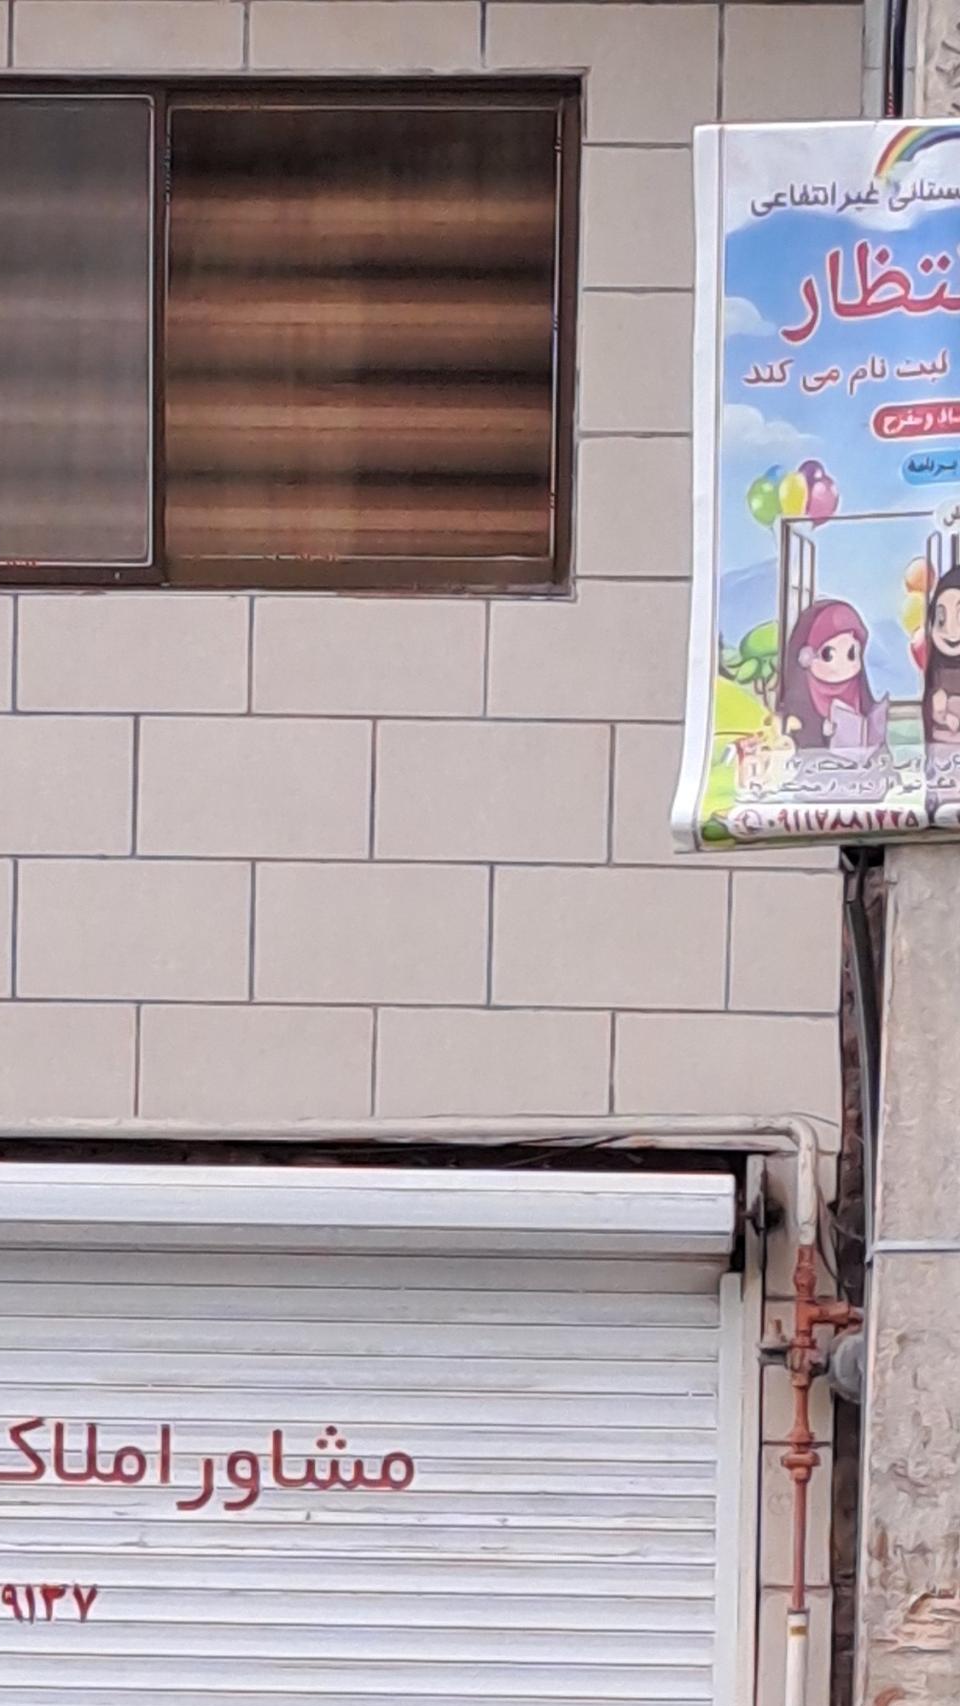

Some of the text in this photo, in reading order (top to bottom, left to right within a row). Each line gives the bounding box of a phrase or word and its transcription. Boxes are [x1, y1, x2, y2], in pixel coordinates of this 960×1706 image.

[888, 178, 960, 212] ستانی
[743, 358, 795, 385] کند
[802, 367, 840, 392] می
[849, 356, 886, 395] نام
[176, 1424, 415, 1511] مشاور
